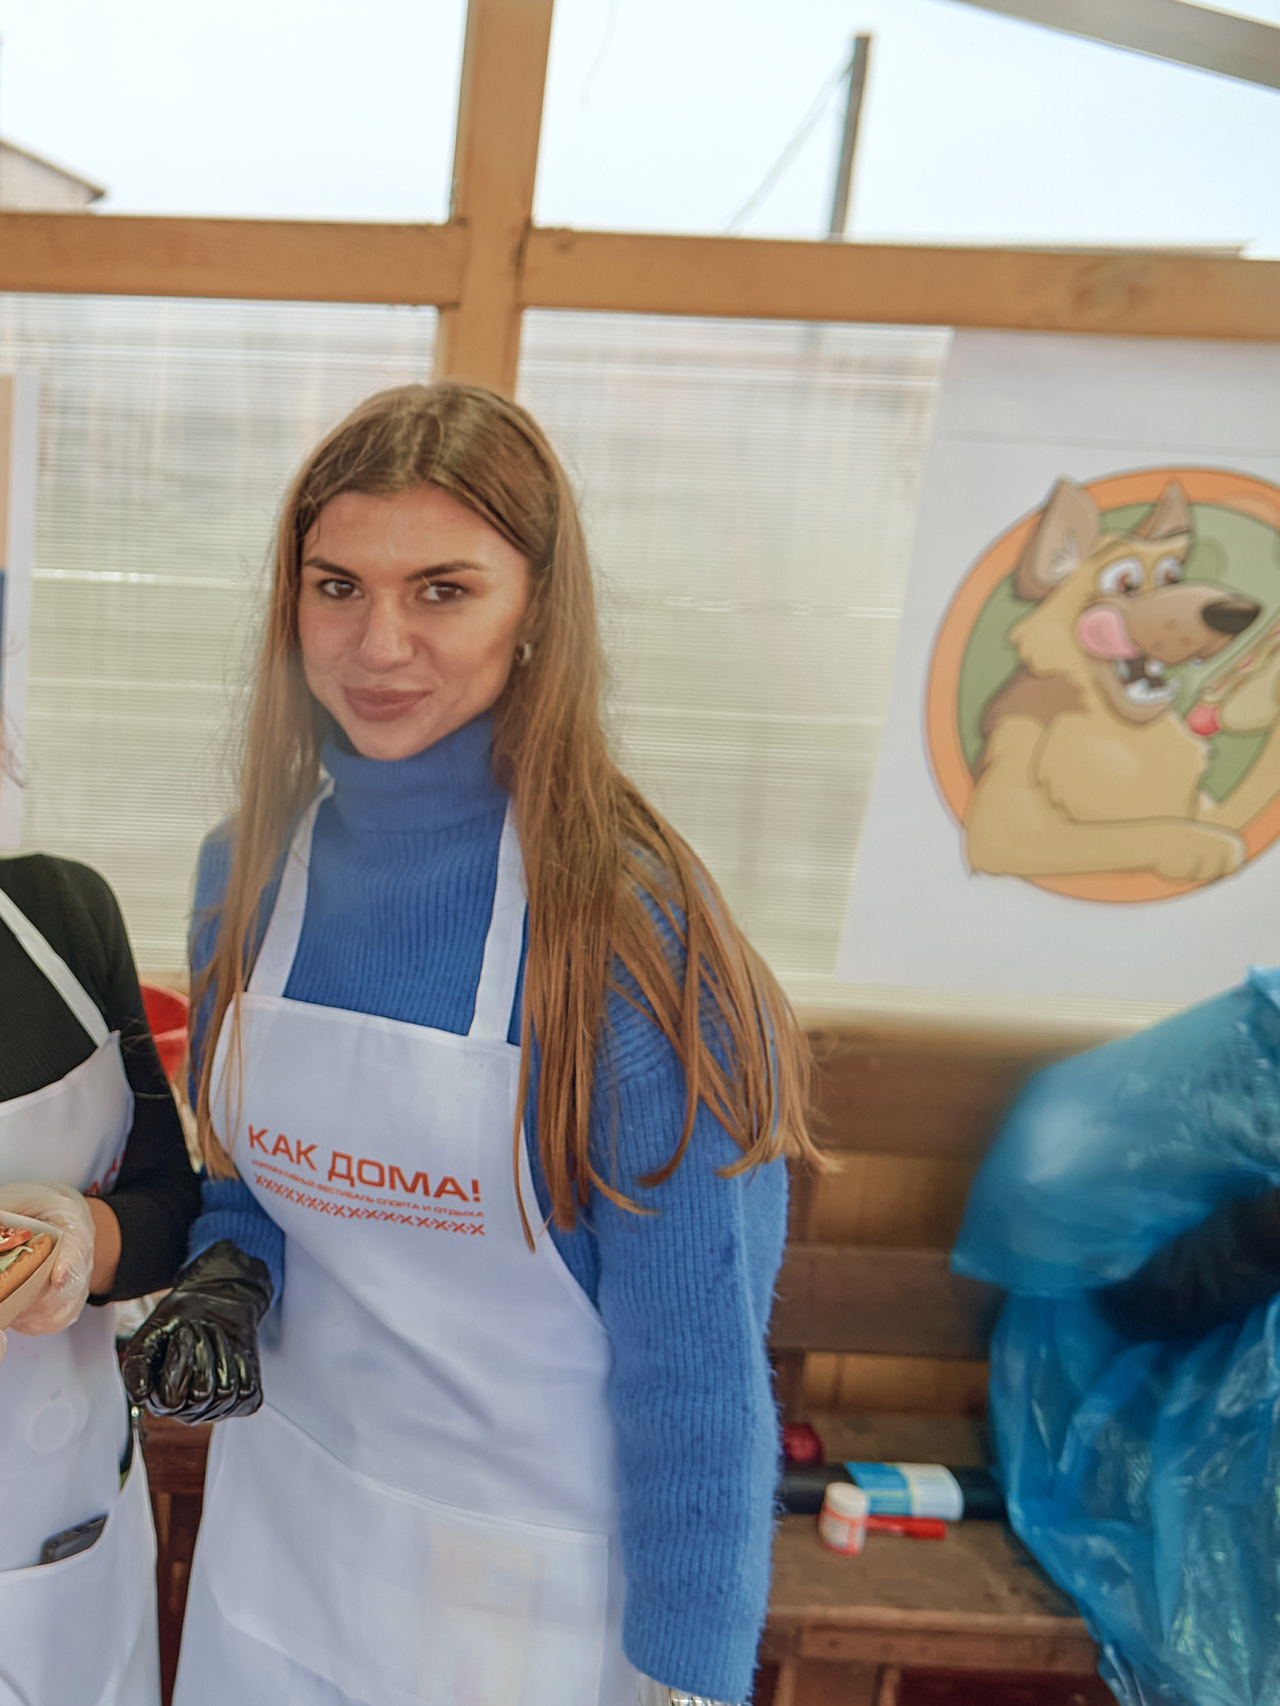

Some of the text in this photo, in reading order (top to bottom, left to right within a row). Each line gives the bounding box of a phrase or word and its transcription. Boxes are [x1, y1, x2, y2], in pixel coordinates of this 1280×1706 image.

[248, 1124, 482, 1202] КАК ДОМА!
[376, 1197, 420, 1210] СПОРТА
